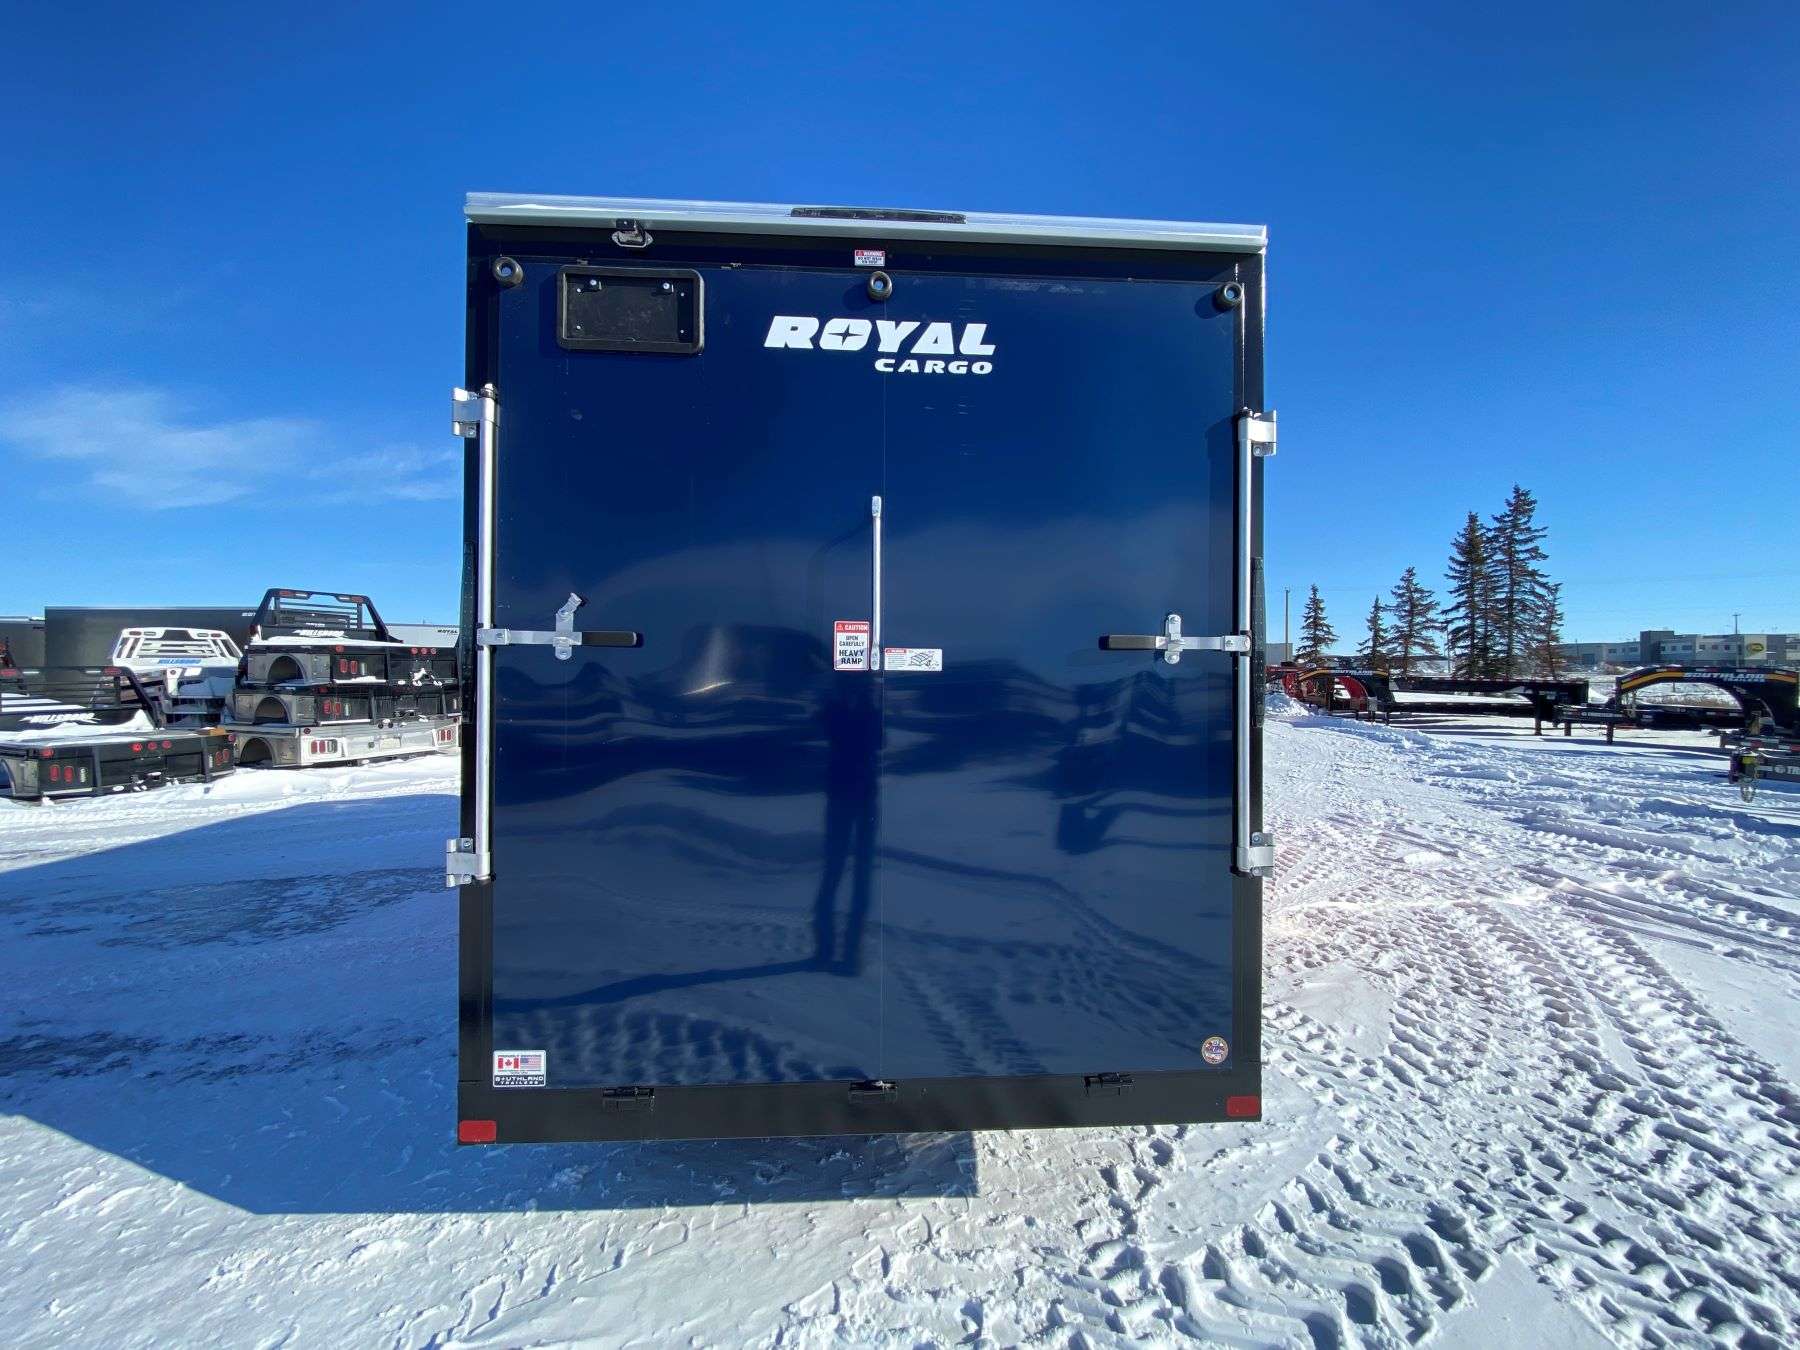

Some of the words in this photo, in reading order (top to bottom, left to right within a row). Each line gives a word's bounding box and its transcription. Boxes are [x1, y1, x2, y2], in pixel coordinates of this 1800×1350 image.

[763, 315, 996, 356] ROYAL
[874, 358, 993, 375] CARGO
[841, 657, 863, 665] RAMP
